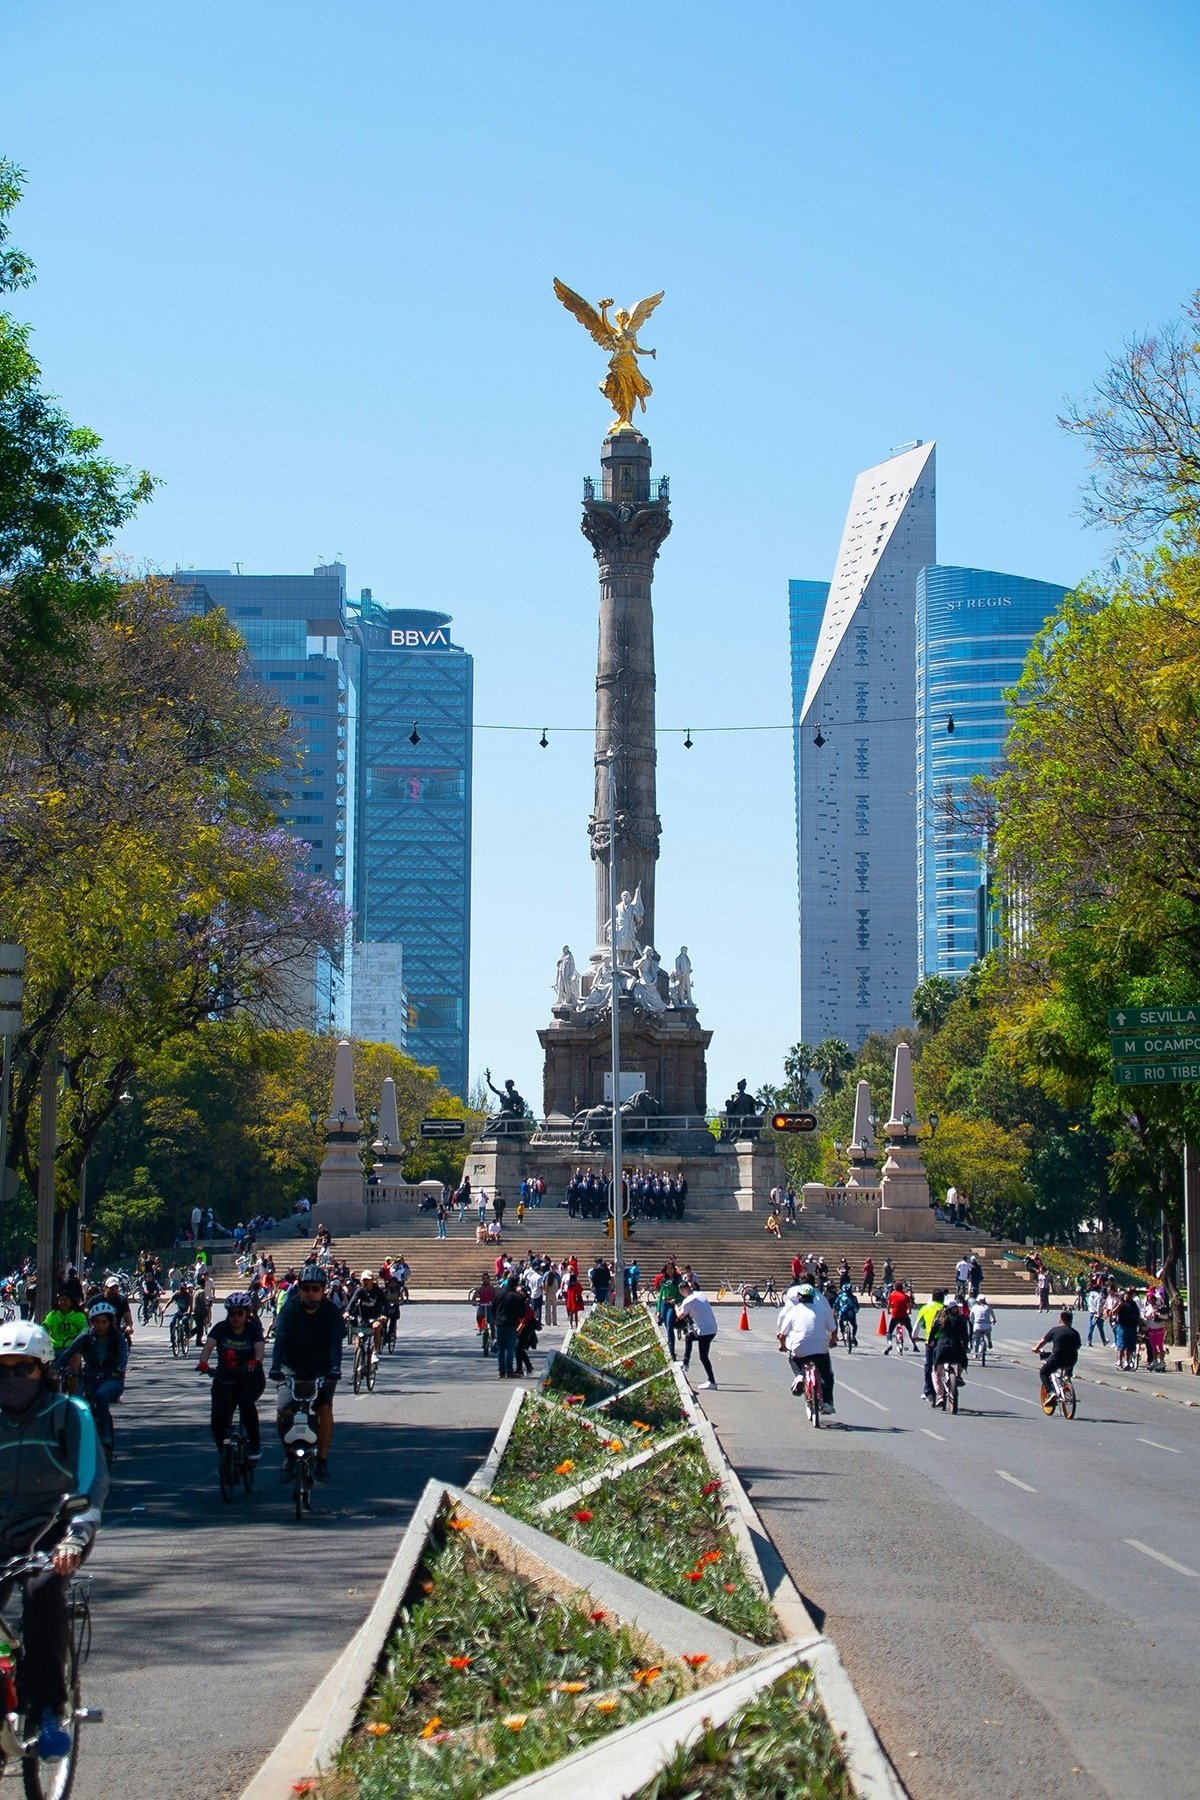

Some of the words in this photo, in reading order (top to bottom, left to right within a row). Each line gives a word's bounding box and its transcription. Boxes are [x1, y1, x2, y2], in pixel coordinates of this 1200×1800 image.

[967, 597, 1012, 608] REGIS
[391, 630, 447, 646] BBVA
[1140, 1010, 1196, 1023] SEVILLA
[1125, 1041, 1135, 1052] M
[1144, 1067, 1165, 1079] RIO
[1171, 1065, 1200, 1078] TIBE
